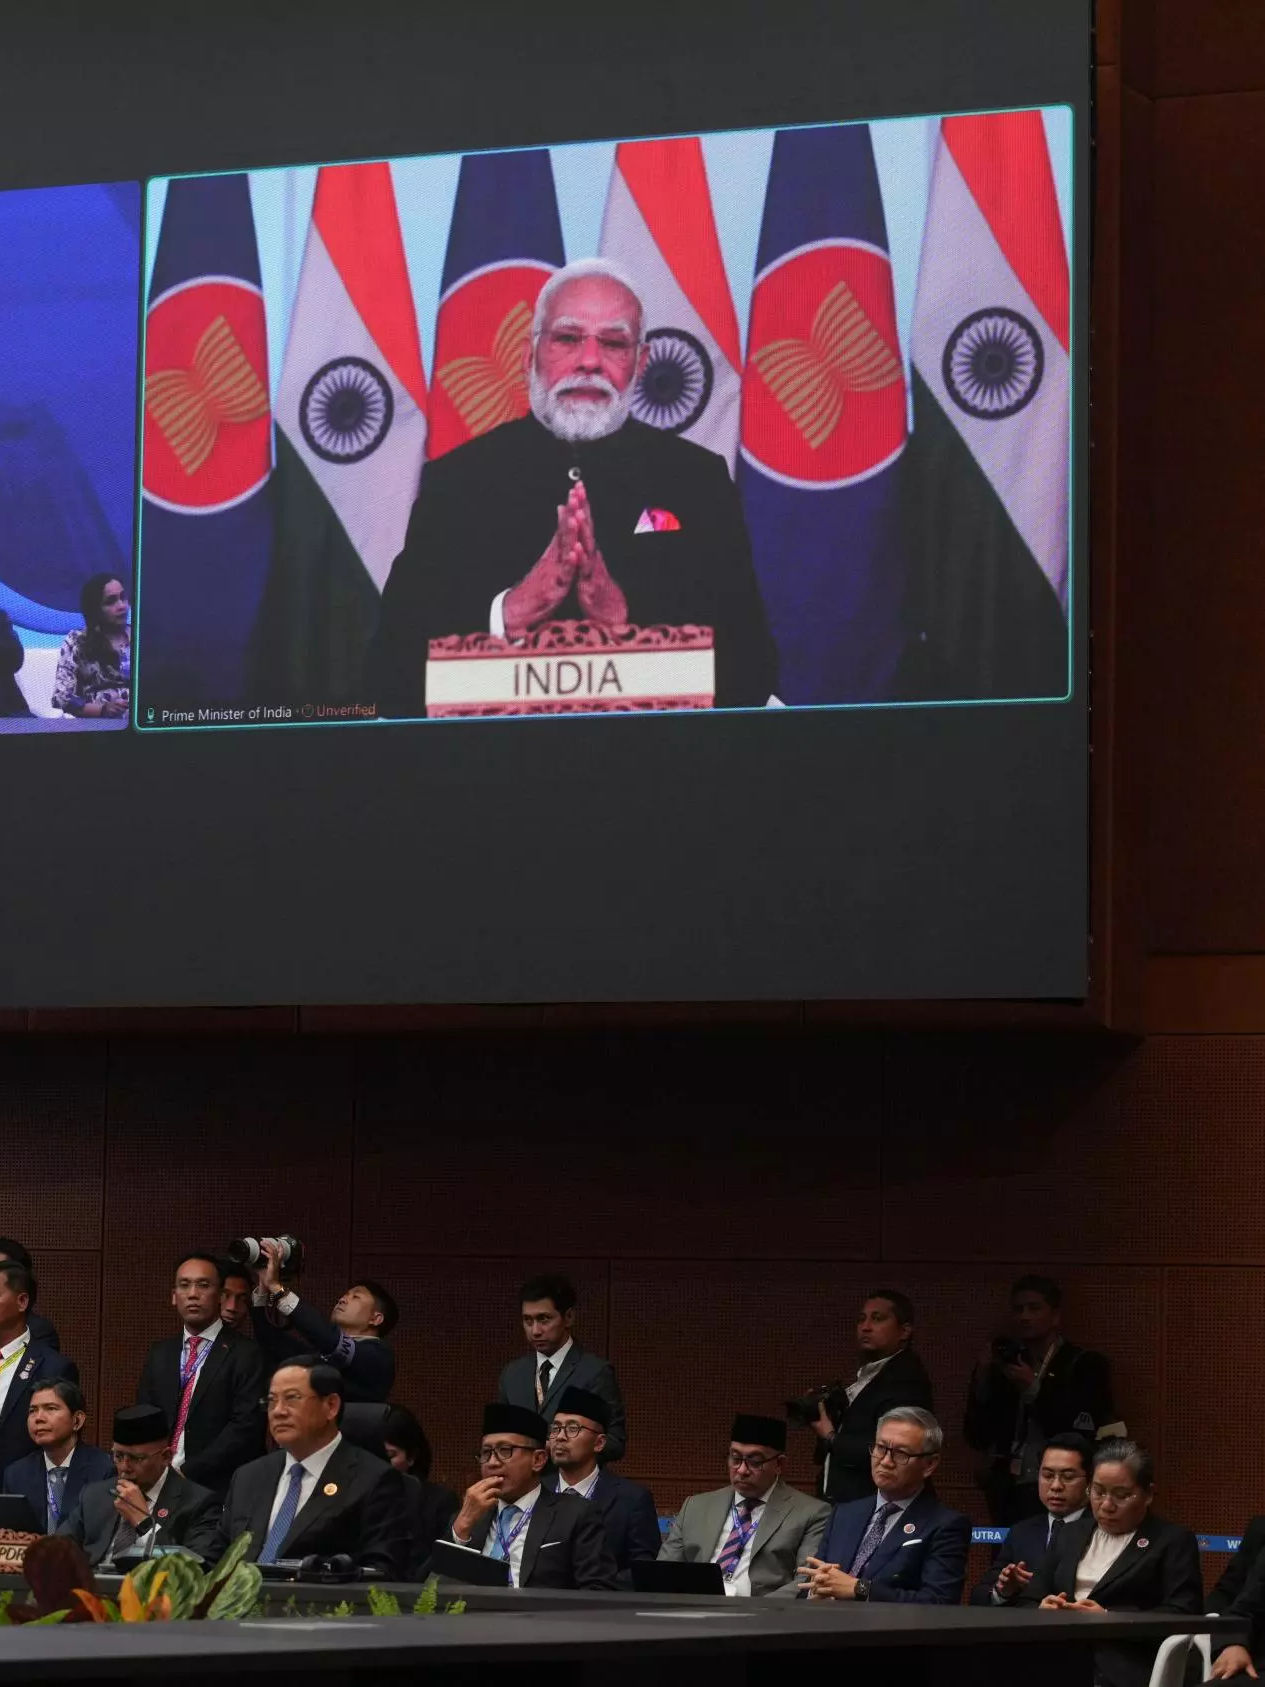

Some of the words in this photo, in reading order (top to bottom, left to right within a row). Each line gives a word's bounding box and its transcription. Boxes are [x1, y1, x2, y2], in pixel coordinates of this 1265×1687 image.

[514, 660, 623, 696] INDIA
[162, 709, 195, 721] Prime
[198, 708, 245, 720] Minister
[248, 706, 261, 719] of
[263, 706, 292, 718] India
[317, 704, 376, 717] Unverified
[972, 1530, 1002, 1540] UTRA
